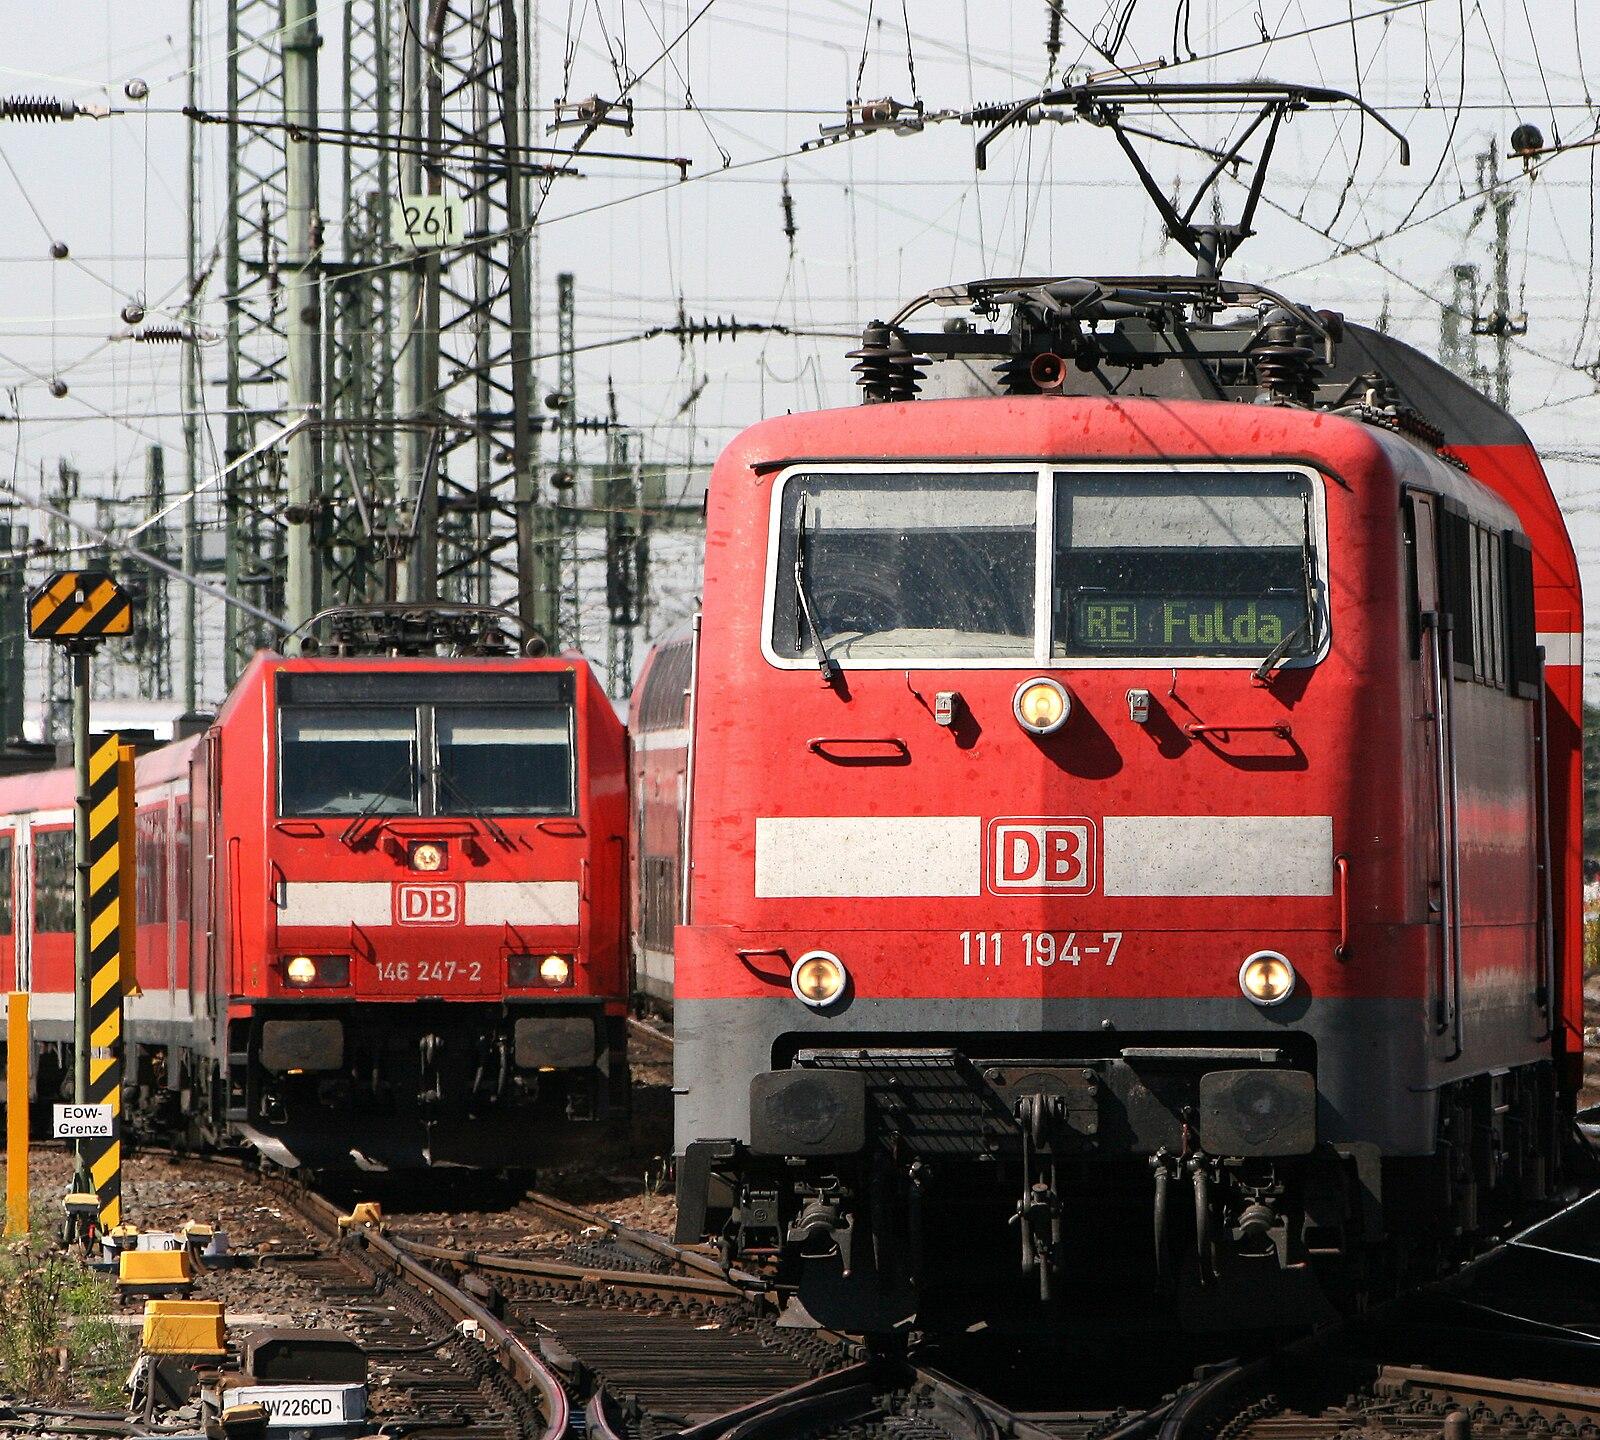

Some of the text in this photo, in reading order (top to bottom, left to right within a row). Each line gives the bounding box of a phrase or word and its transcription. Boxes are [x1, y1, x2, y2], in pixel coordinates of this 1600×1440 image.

[404, 206, 453, 235] 261
[1087, 602, 1283, 644] RE Fulda
[1002, 829, 1083, 882] DB
[404, 889, 452, 919] DB
[958, 931, 1124, 967] 111 194-7
[375, 961, 482, 982] 146 247-2
[63, 1107, 103, 1119] EOW-
[58, 1123, 108, 1135] Grenze
